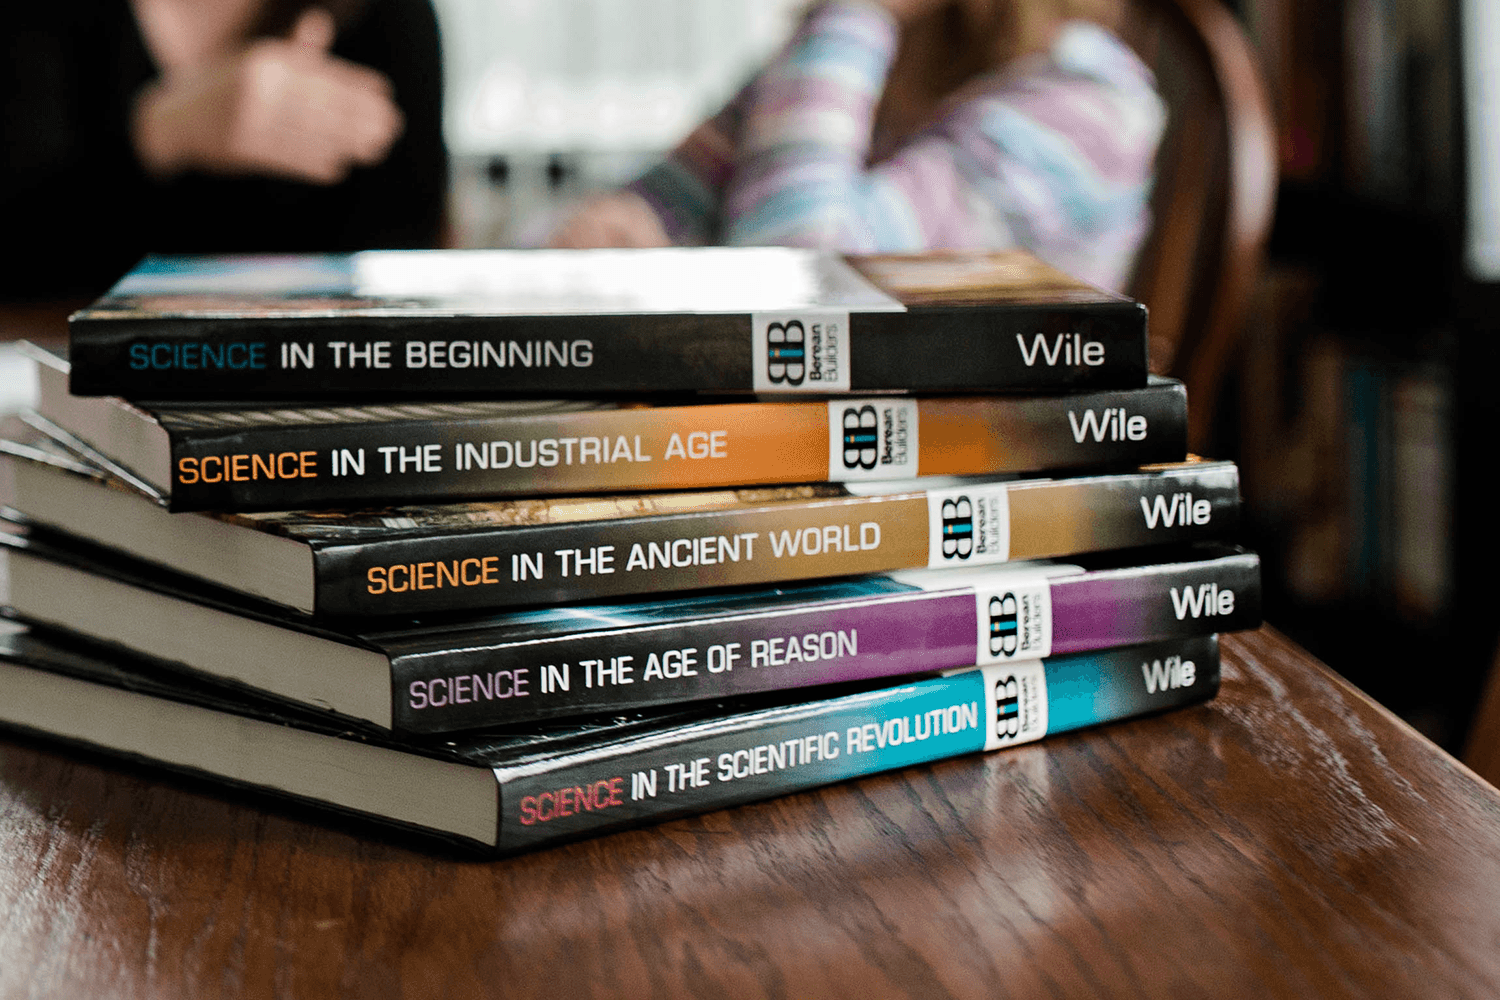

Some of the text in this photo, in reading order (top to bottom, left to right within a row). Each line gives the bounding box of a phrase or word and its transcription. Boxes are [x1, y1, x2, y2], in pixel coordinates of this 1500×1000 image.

[129, 339, 595, 370] SCIENCE IN THE BEGINNING
[809, 323, 822, 381] Berean
[824, 323, 839, 382] Builders
[1015, 332, 1106, 368] Wile
[881, 408, 893, 465] Berean
[1068, 407, 1148, 444] Wile
[178, 429, 729, 485] SCIENCE IN THE INDUSTRIAL AGE
[976, 497, 987, 554] Berean
[1140, 492, 1212, 530] Wile
[366, 520, 882, 596] SCIENCE IN THE ANCIENT WORLD
[1169, 582, 1235, 621] Wile
[409, 628, 859, 711] SCIENCE IN THE AGE OF REASON
[1141, 655, 1197, 695] Wile
[519, 700, 979, 827] SCIENCE IN THE SCIENTIFIC REVOLUTION
